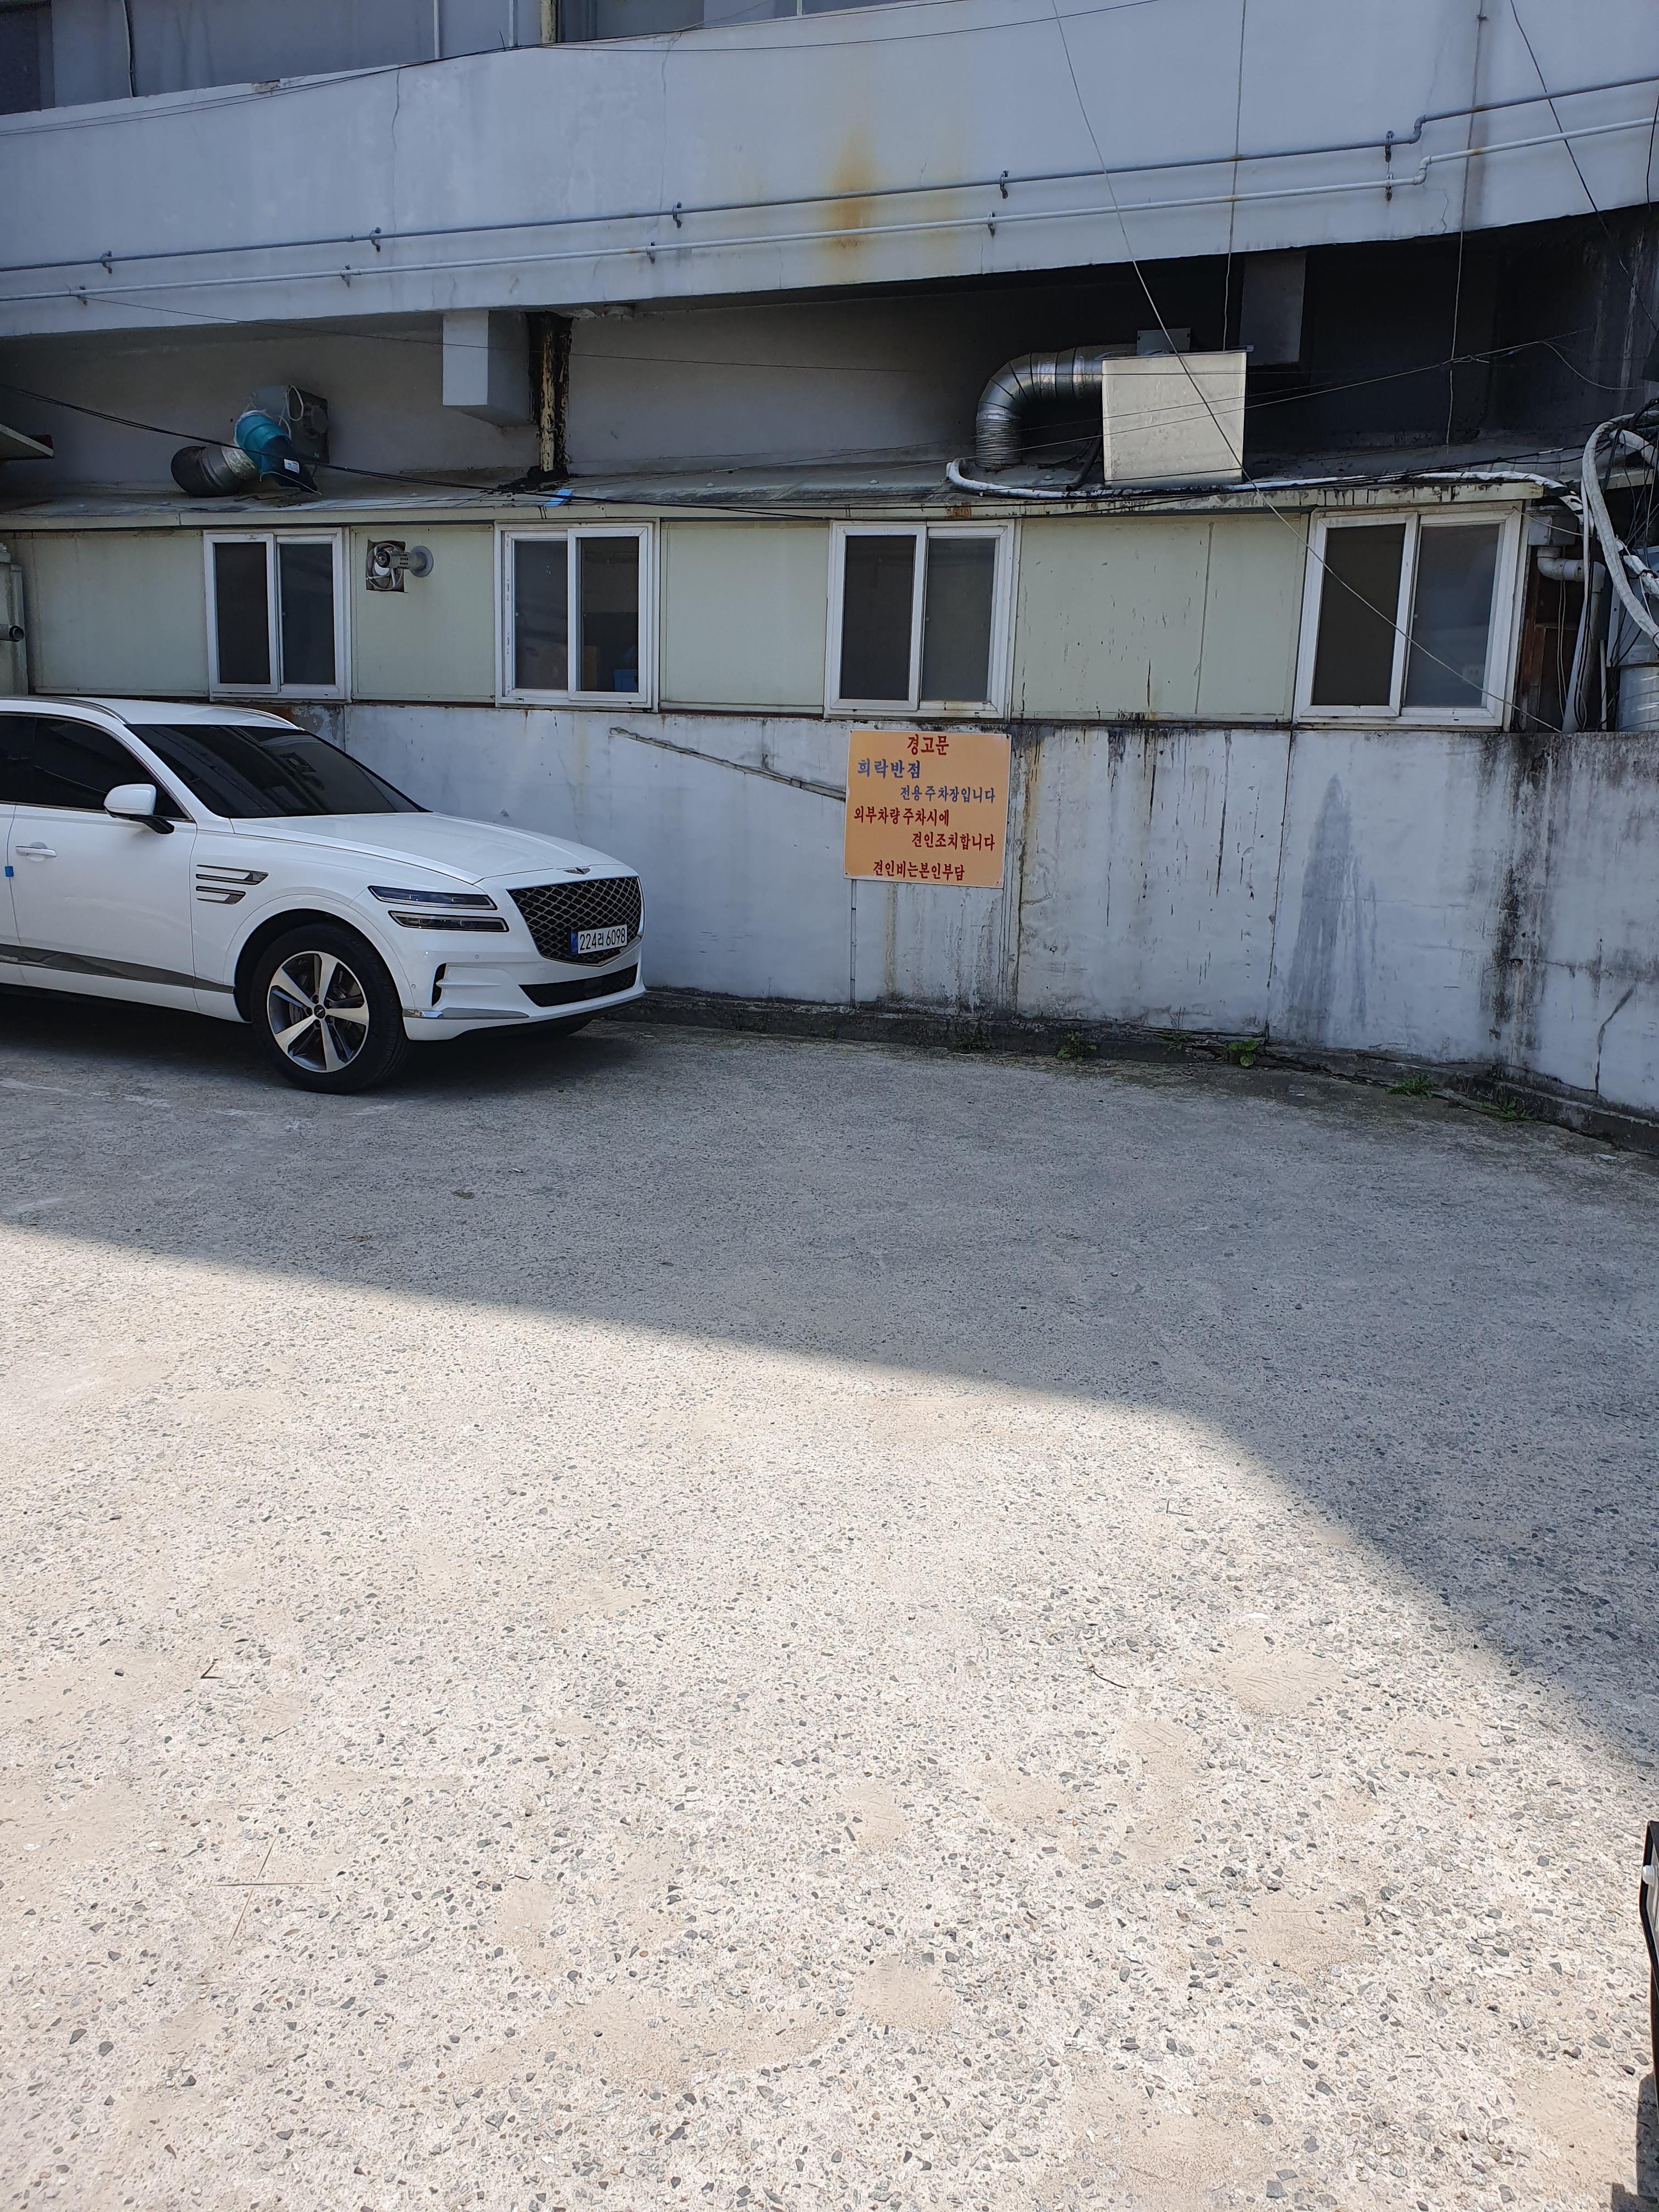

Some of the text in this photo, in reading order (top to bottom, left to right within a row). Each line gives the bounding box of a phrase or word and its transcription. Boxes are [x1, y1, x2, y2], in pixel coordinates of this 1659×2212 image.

[907, 733, 950, 756] 경고문
[857, 758, 921, 780] 희락반점
[606, 928, 625, 946] 6098
